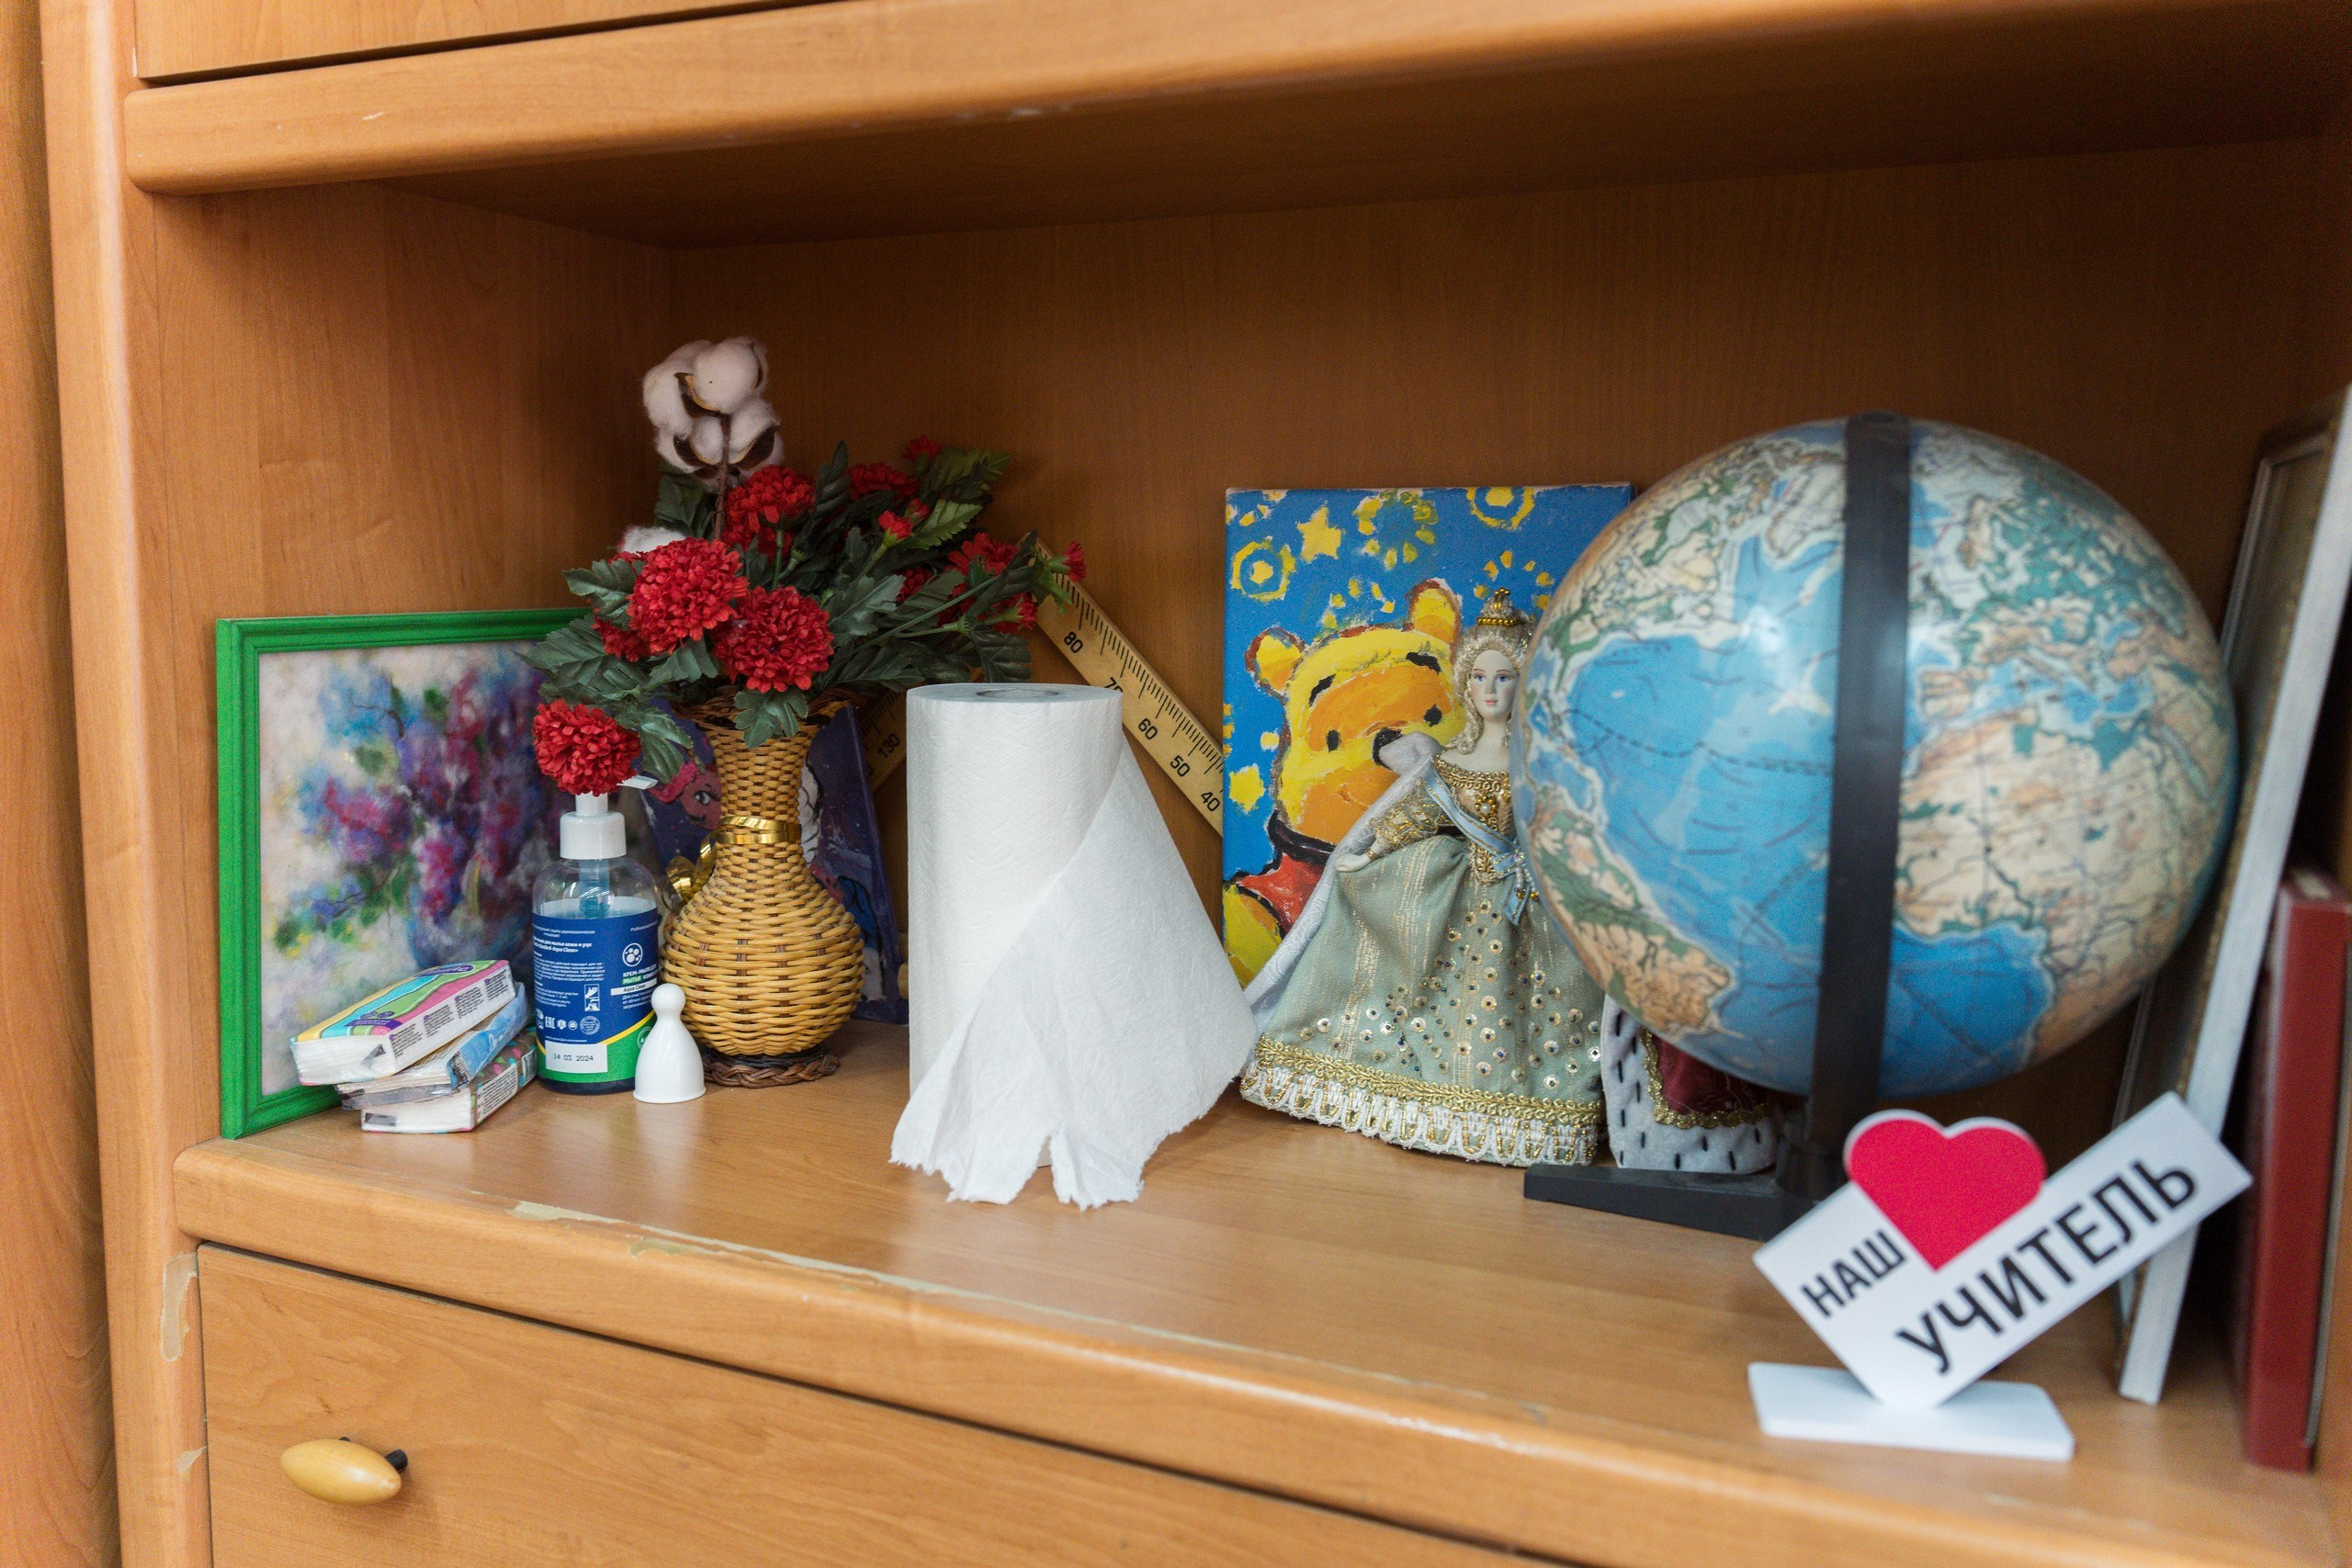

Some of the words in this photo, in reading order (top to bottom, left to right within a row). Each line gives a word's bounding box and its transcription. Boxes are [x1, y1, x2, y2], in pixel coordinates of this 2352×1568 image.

[877, 733, 900, 759] 130
[1064, 631, 1083, 653] 80
[1137, 717, 1158, 740] 60
[1170, 755, 1191, 777] 50
[1201, 791, 1220, 812] 40
[1799, 1228, 1907, 1318] НАШ
[1895, 1158, 2198, 1376] УЧИТЕЛЬ
